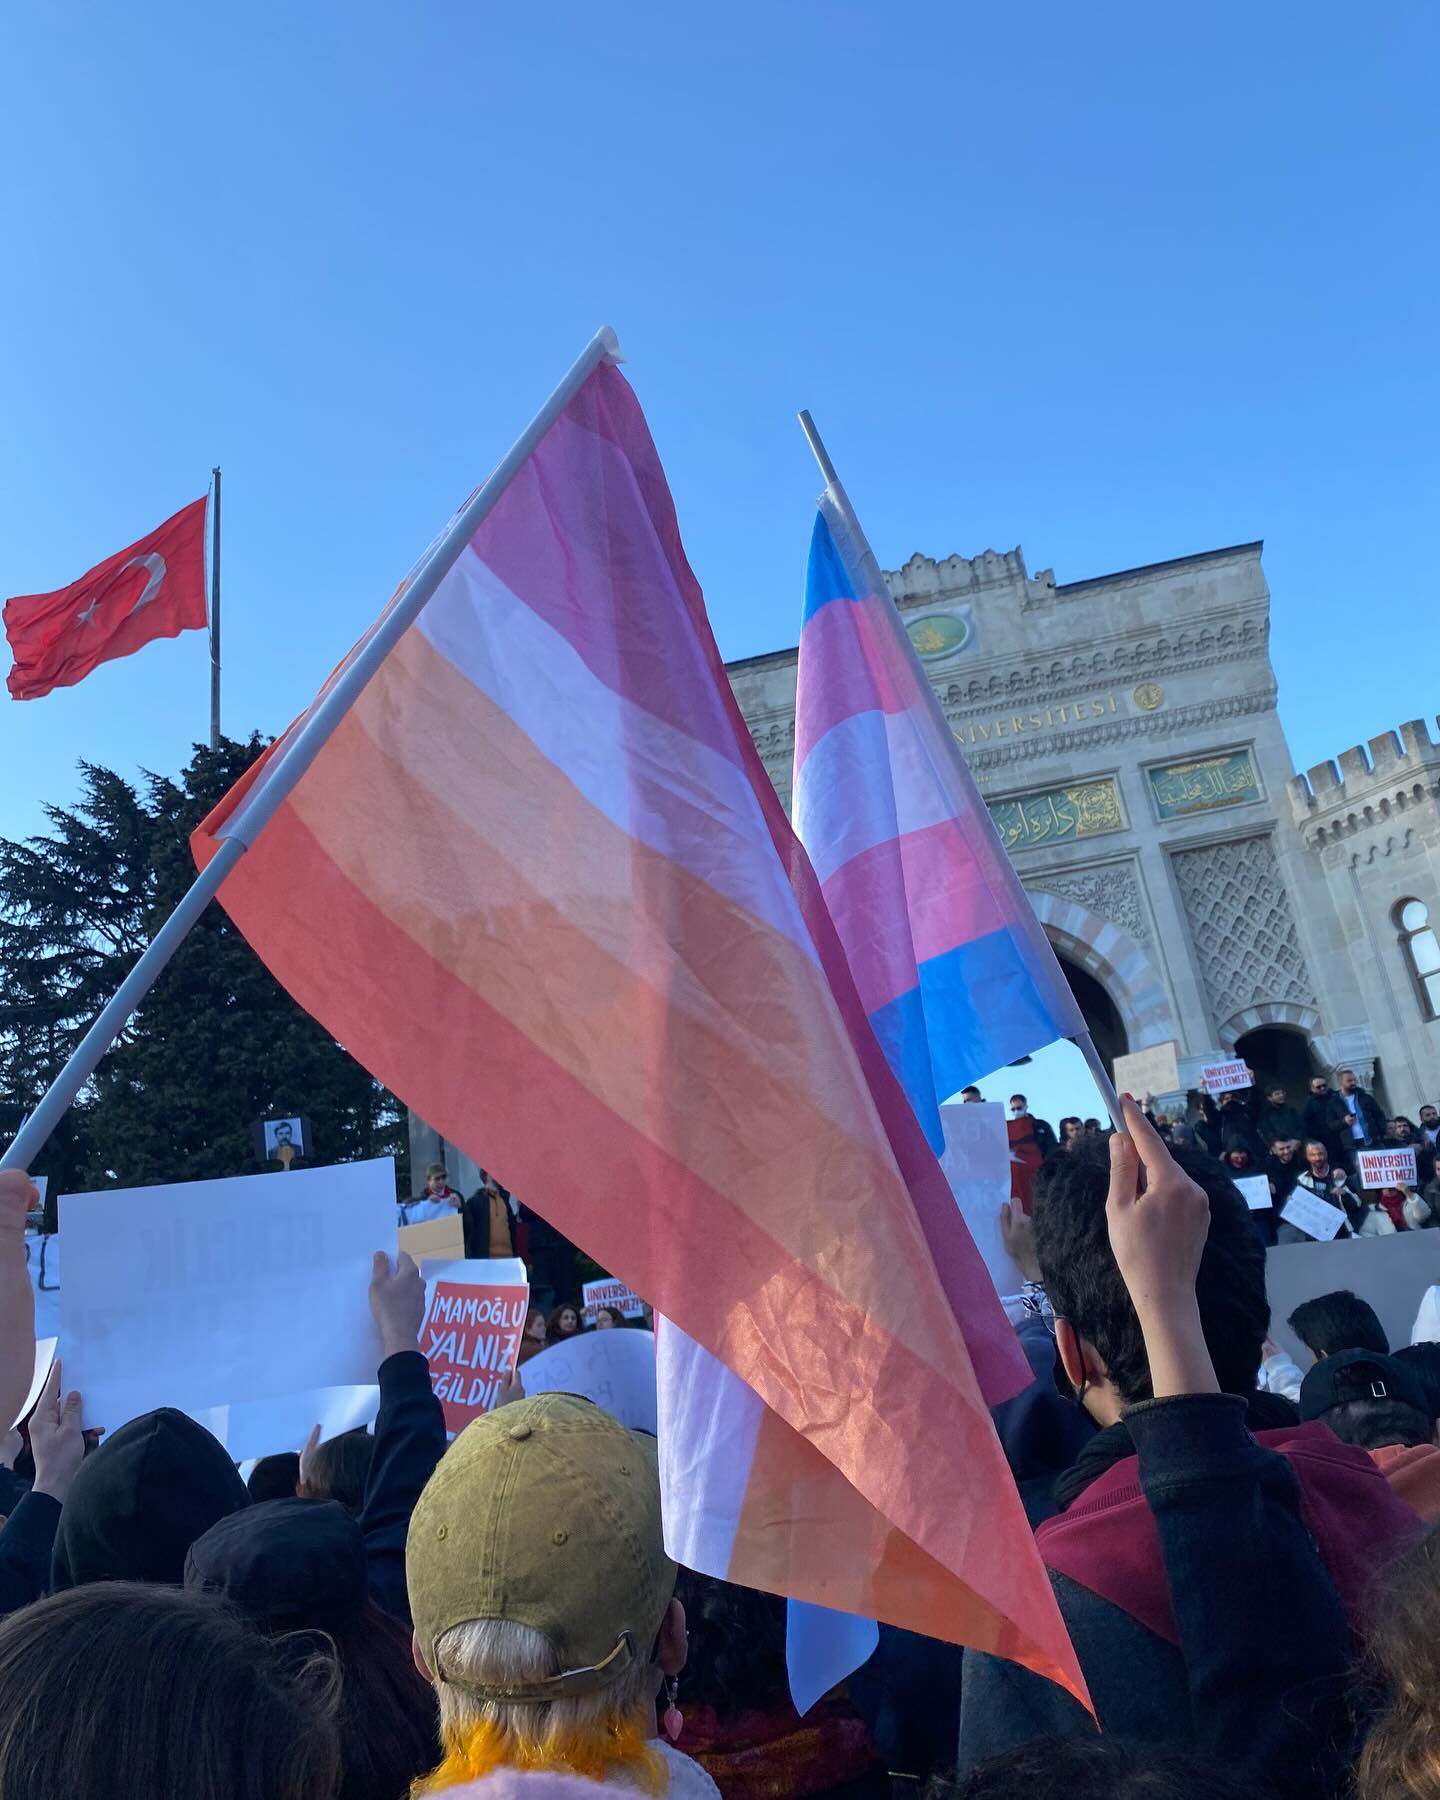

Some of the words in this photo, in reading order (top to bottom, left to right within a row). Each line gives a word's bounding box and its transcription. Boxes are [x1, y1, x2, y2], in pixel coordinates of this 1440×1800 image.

[953, 692, 1118, 745] NİVERSİTESİ
[1362, 1152, 1414, 1169] ÜNİVERSİTE
[1385, 1168, 1415, 1182] ETMEZ!
[430, 1291, 525, 1328] İMAMOĞLU
[425, 1328, 517, 1373] YALNIZ
